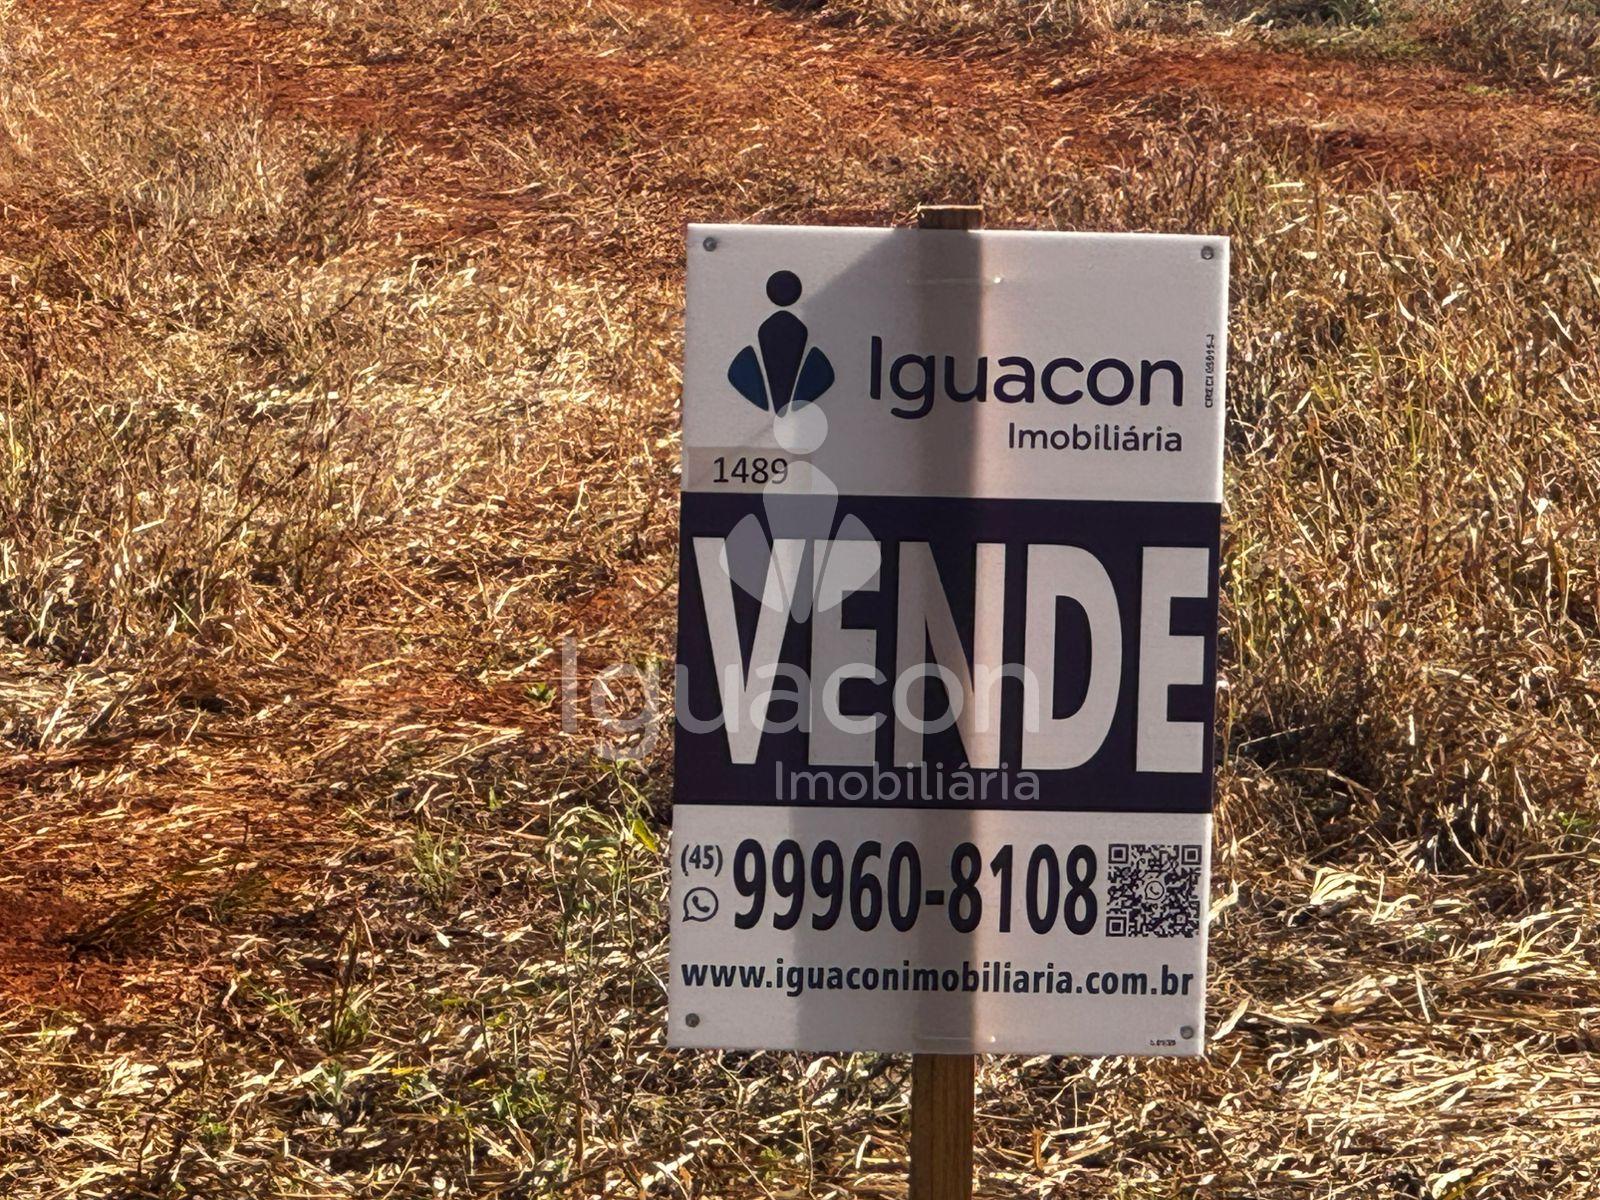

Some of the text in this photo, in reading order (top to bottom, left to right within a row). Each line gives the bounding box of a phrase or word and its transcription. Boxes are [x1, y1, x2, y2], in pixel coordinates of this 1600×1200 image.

[870, 336, 1184, 418] Iguacon
[1009, 422, 1182, 452] Imobiliária
[712, 457, 789, 484] 1489
[693, 537, 1210, 773] VENDE
[681, 838, 1098, 936] (45) 99960-8108
[681, 958, 1194, 997] www.iguaconimobiliaria.com.br
